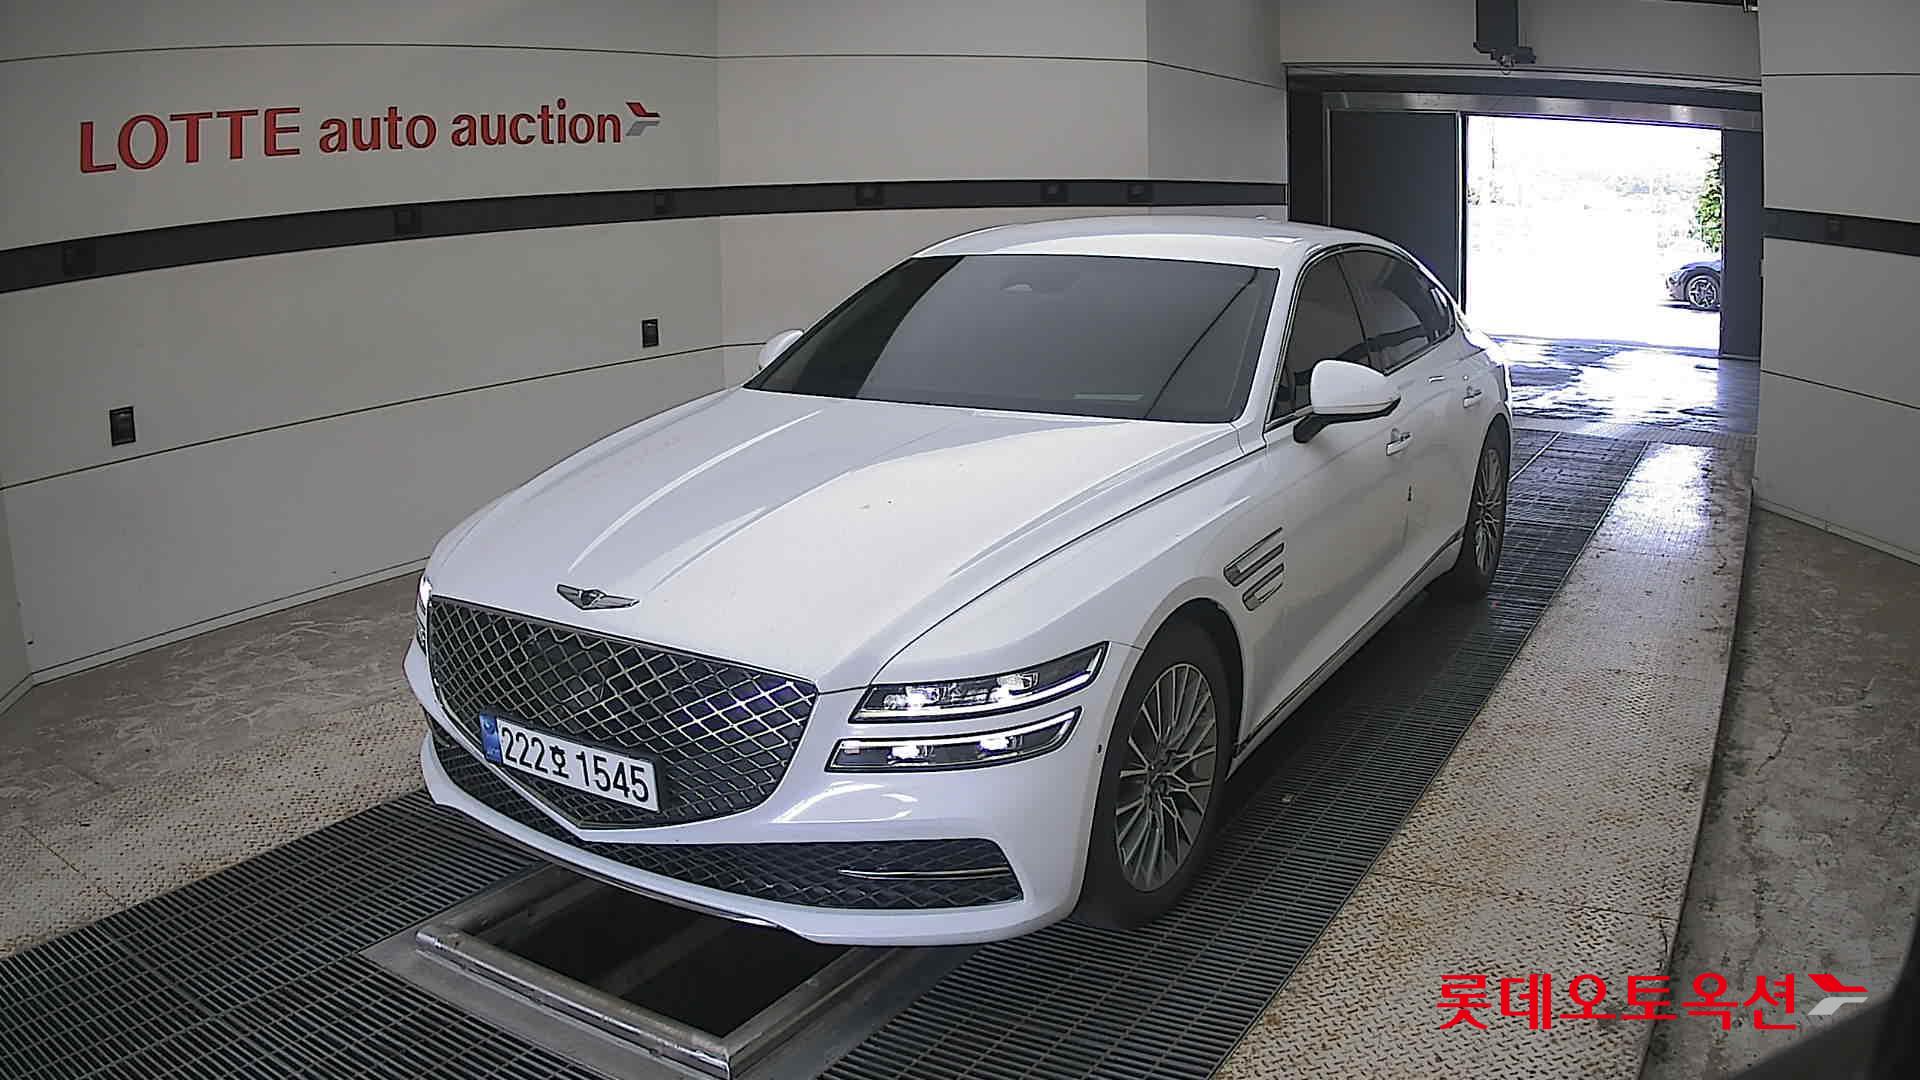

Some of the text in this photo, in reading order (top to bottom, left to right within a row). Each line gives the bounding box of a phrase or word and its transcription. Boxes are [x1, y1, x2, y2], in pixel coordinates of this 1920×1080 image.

[80, 98, 622, 174] LOTTE auto auction
[501, 726, 650, 803] 222호 1545
